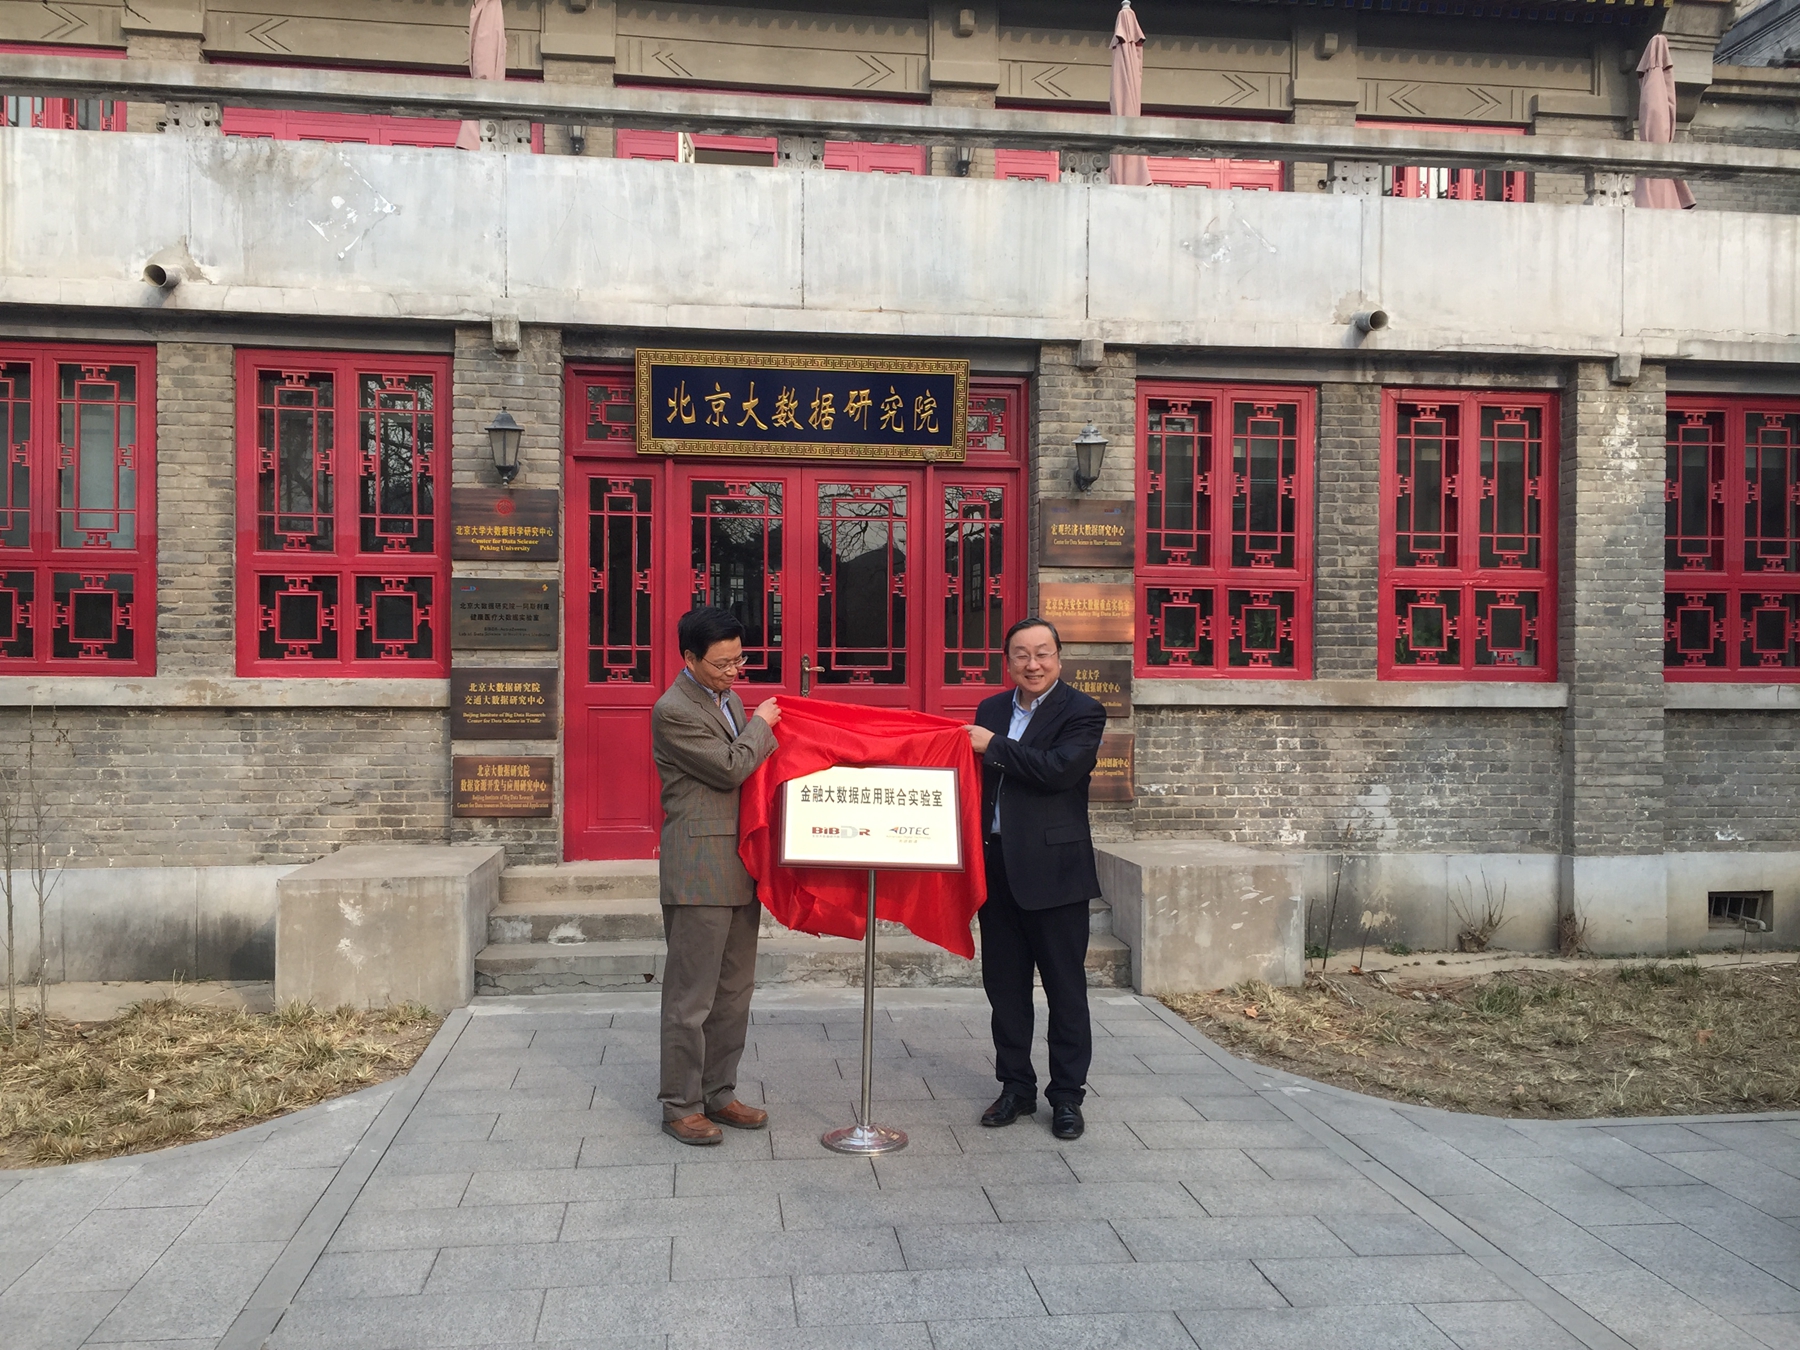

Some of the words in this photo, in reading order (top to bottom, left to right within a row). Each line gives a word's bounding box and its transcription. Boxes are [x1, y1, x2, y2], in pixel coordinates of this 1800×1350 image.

[667, 380, 940, 433] 北京大数据研究院
[456, 525, 554, 537] 北京大学大数据科学研究中心
[1051, 524, 1126, 536] 宏观经济大数据研究中心
[1075, 669, 1100, 680] 北京大学
[468, 682, 541, 693] 北京大数据研究院
[465, 695, 545, 705] 交通大数据研究中心
[477, 764, 530, 777] 北京大数据研究院
[460, 779, 547, 792] 数据资源开发与应用研究中心
[800, 785, 943, 807] 金融大数据应用联合实验室
